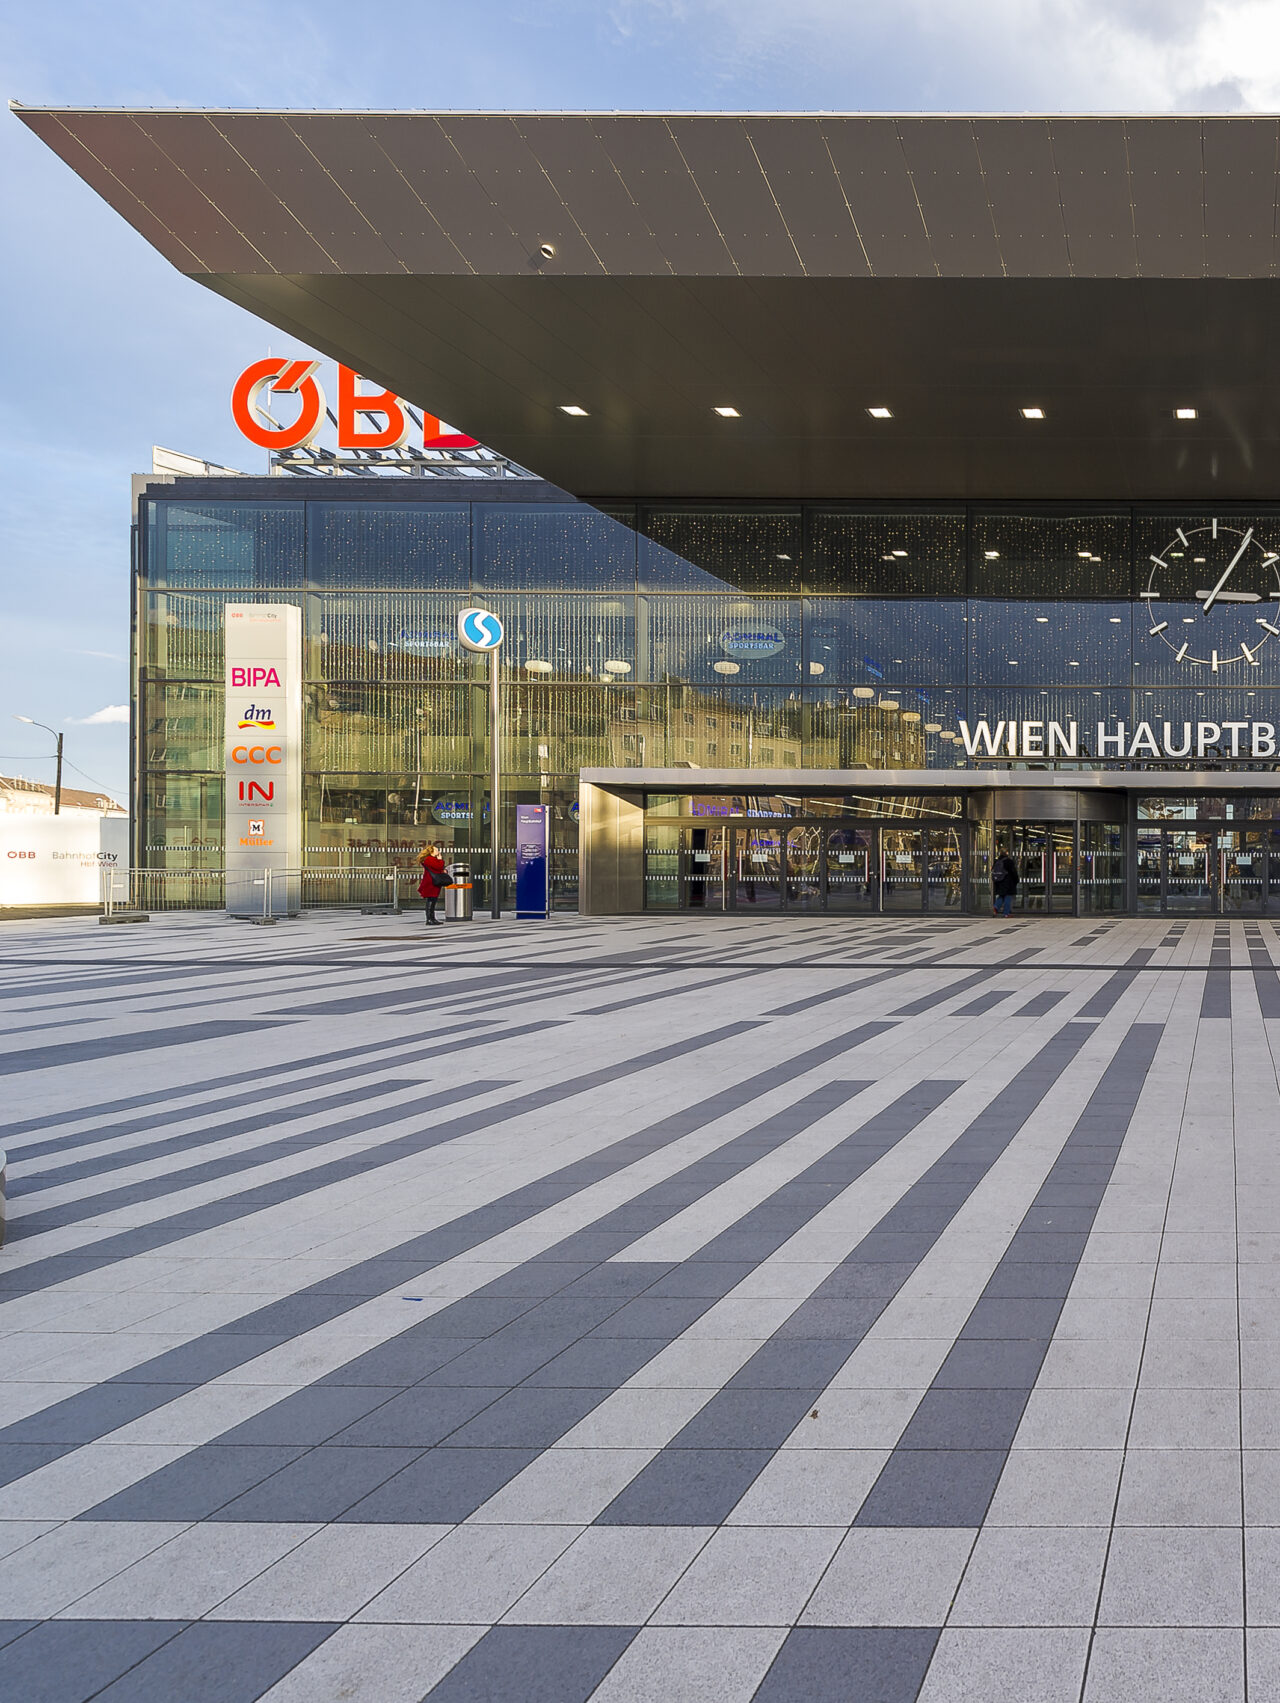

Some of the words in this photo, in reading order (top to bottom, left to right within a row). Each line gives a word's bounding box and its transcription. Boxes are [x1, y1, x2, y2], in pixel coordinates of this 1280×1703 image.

[231, 668, 281, 687] BIPA
[244, 704, 272, 720] dm
[958, 720, 1077, 757] WIEN
[231, 746, 282, 764] CCC
[239, 781, 274, 801] IN
[239, 838, 274, 846] Müller
[52, 852, 118, 861] BahnhofCity
